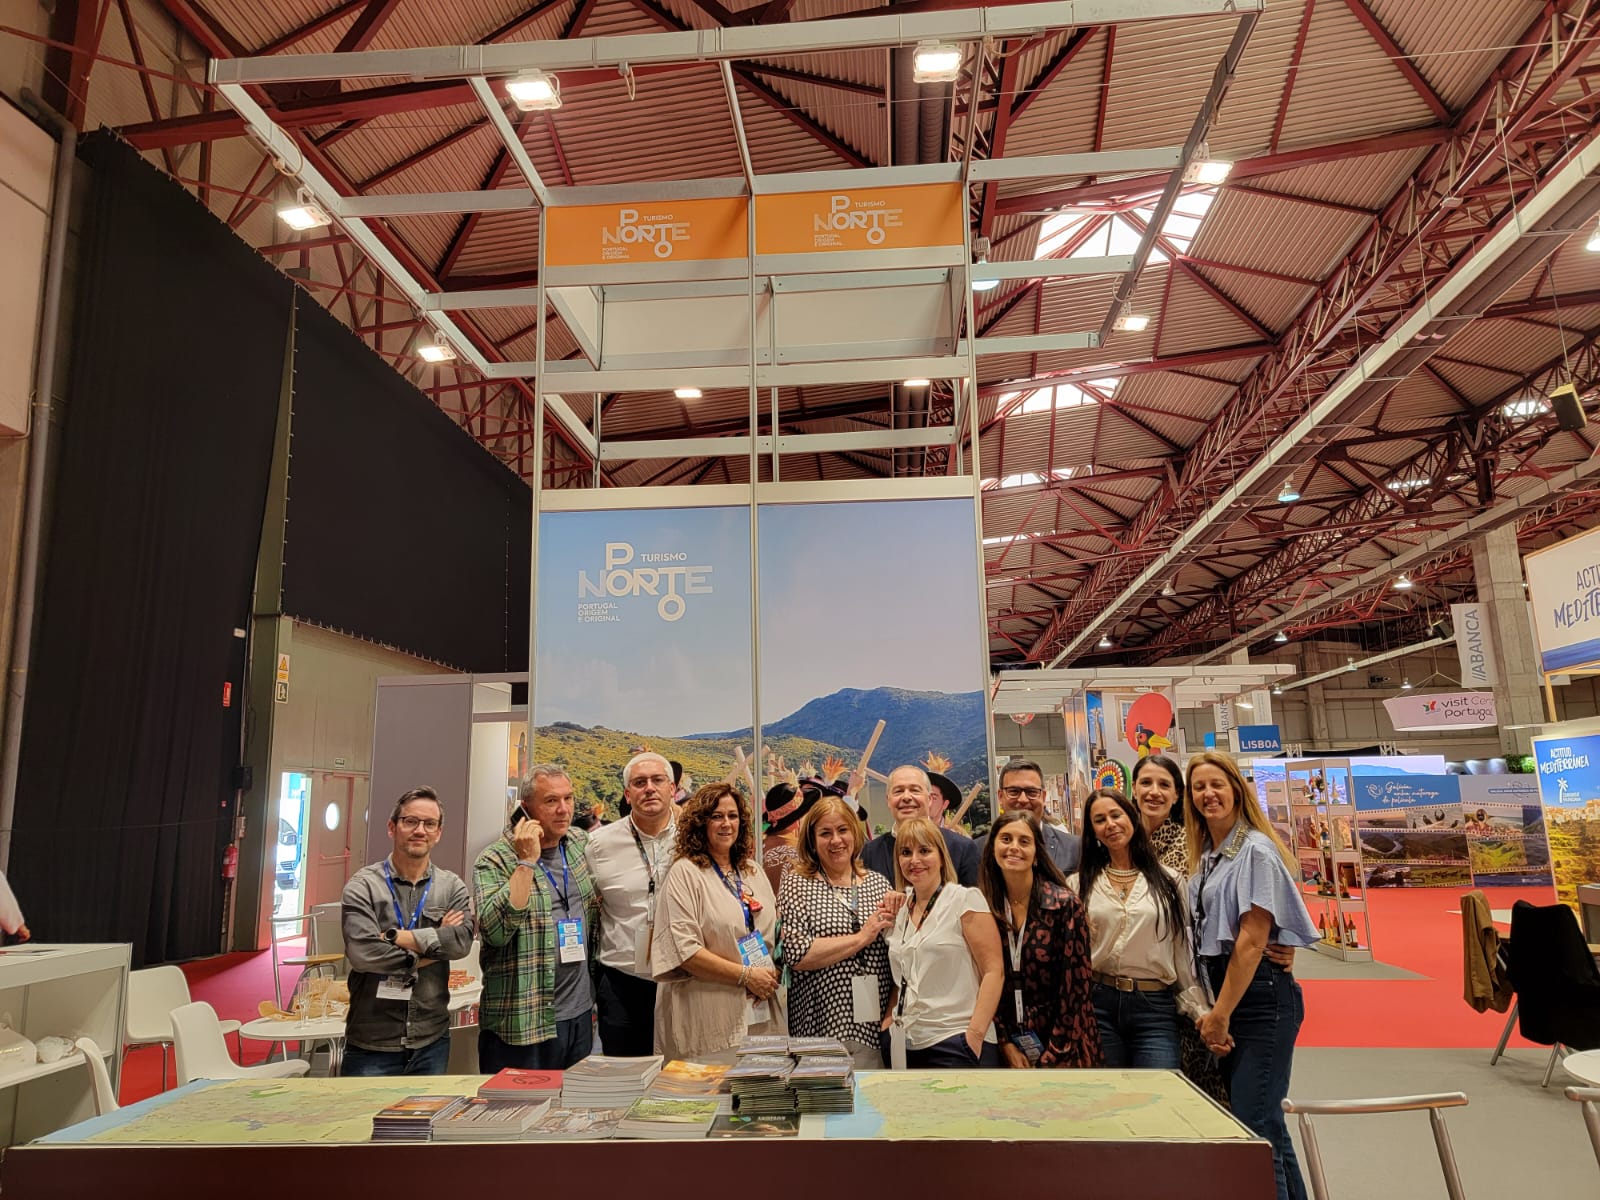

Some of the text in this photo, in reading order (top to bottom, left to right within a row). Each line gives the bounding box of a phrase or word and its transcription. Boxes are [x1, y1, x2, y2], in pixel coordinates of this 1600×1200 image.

[854, 200, 886, 208] TURISMO
[640, 552, 688, 562] TURISMO
[1576, 564, 1600, 592] ACTI
[578, 602, 618, 611] PORTUGAL
[578, 609, 608, 617] ORIGEM
[584, 615, 621, 623] ORIGINAL
[1441, 696, 1468, 708] visit
[1241, 739, 1279, 750] LISBOA
